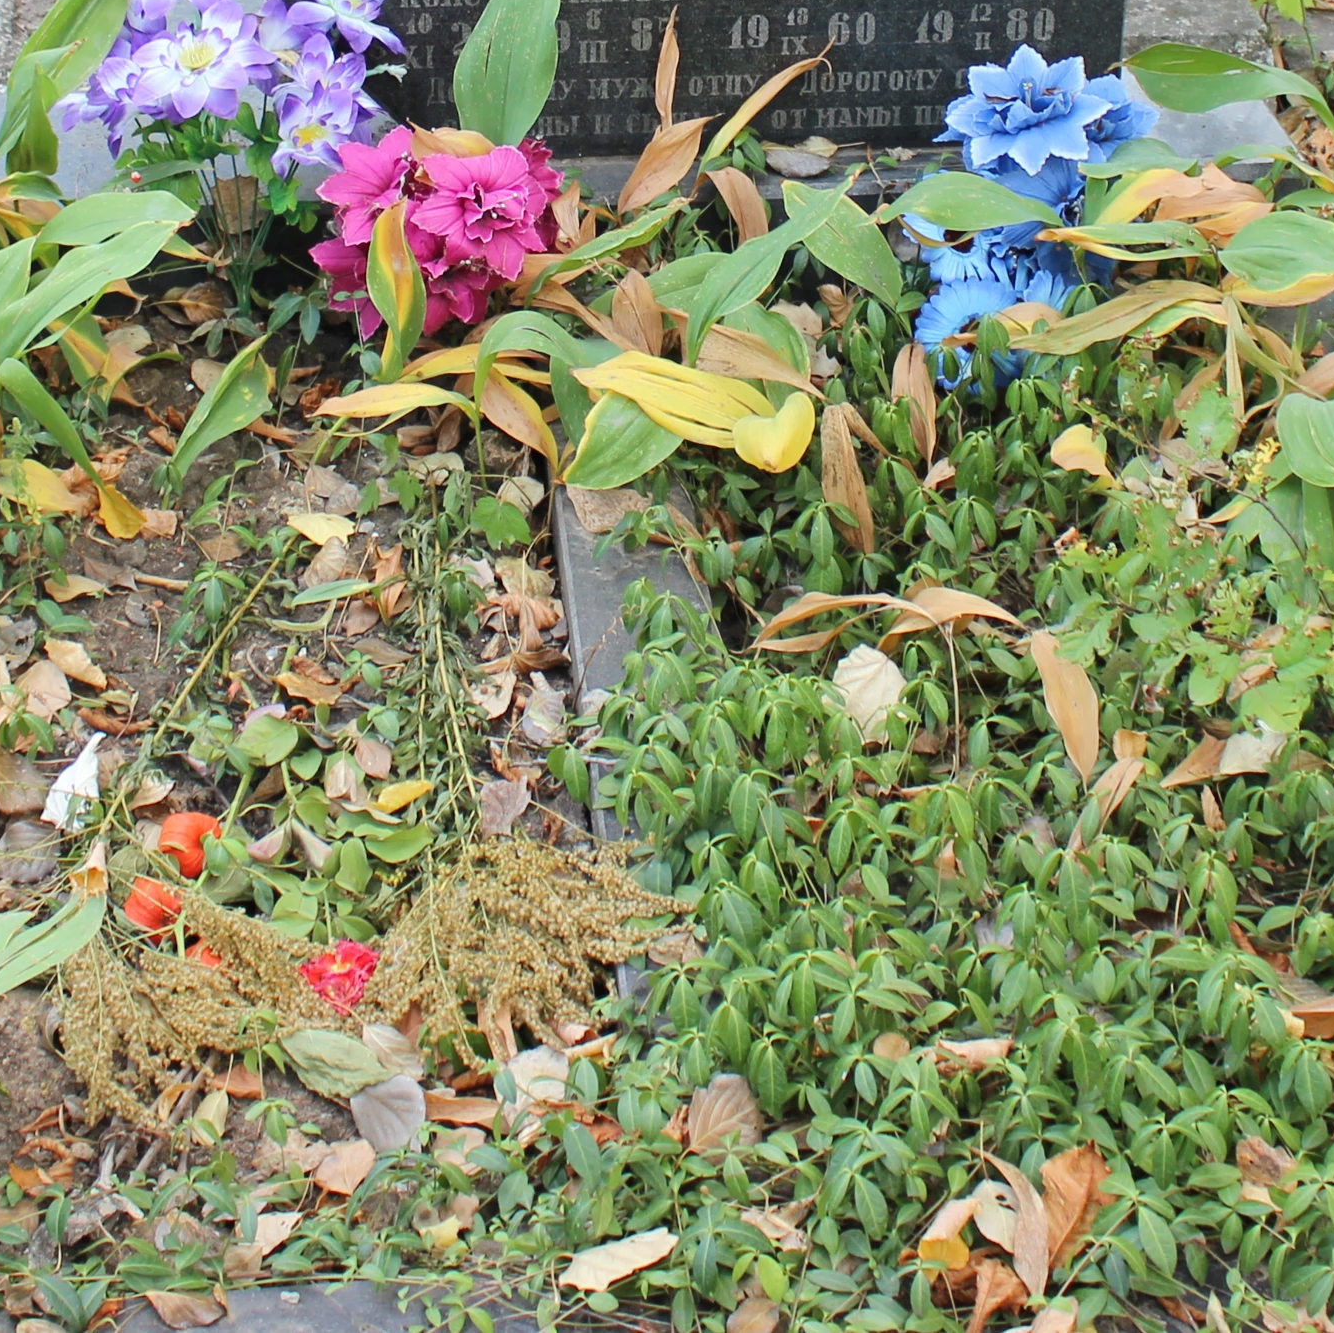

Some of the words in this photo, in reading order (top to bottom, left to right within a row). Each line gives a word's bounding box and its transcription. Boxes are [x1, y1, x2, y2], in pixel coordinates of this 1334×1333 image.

[729, 14, 770, 50] 19
[786, 7, 809, 27] 18
[827, 12, 876, 46] 60
[915, 10, 954, 45] 19
[970, 4, 992, 23] 12
[1006, 7, 1056, 42] 80
[587, 77, 657, 100] МУЖ
[688, 74, 764, 100] ОТЦУ
[799, 68, 943, 96] ДОРОГОМУ
[771, 109, 806, 130] ОТ
[817, 106, 901, 129] МАМЫ
